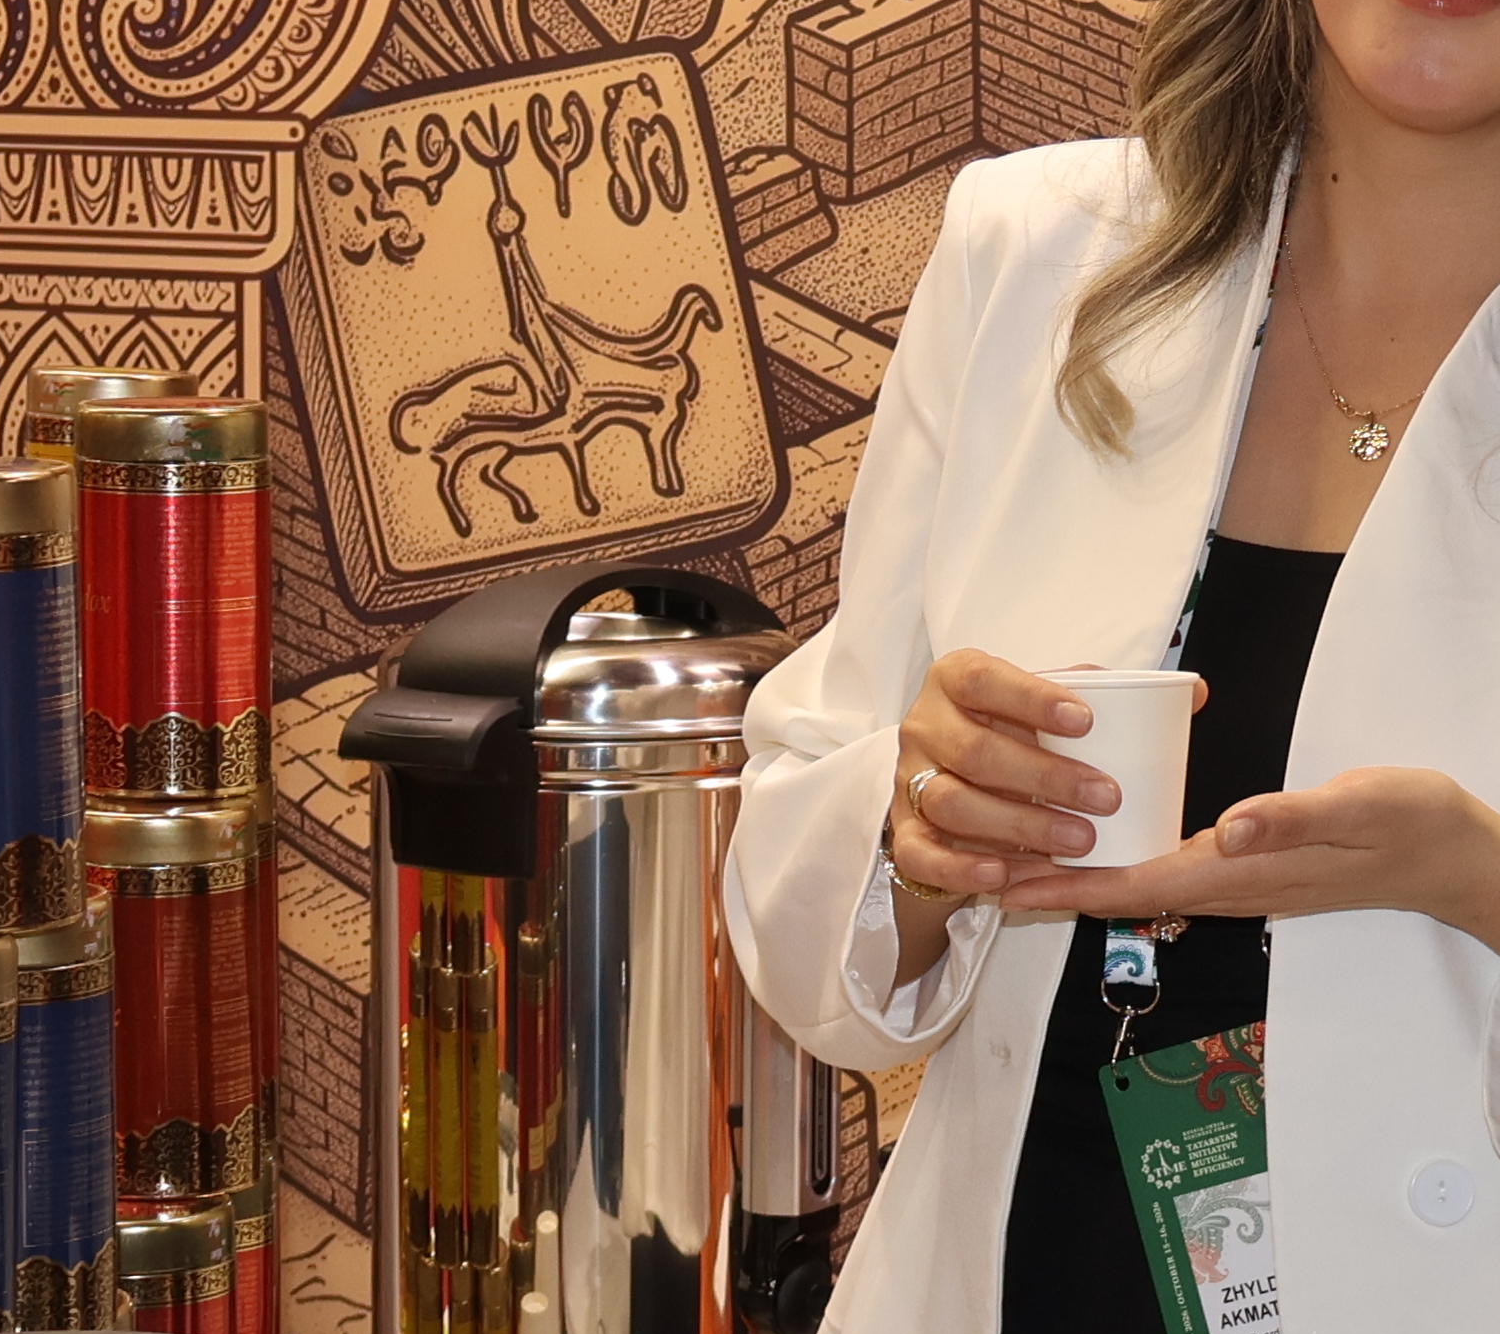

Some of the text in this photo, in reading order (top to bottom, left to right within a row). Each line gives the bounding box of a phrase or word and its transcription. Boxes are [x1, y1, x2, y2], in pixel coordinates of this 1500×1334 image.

[1185, 1131, 1238, 1152] TATARSTAN
[1188, 1140, 1238, 1160] INITIATIVE
[1190, 1152, 1230, 1169] MUTUAL
[1192, 1156, 1245, 1177] EFFICIENCY
[1166, 1255, 1185, 1305] OCTOBER
